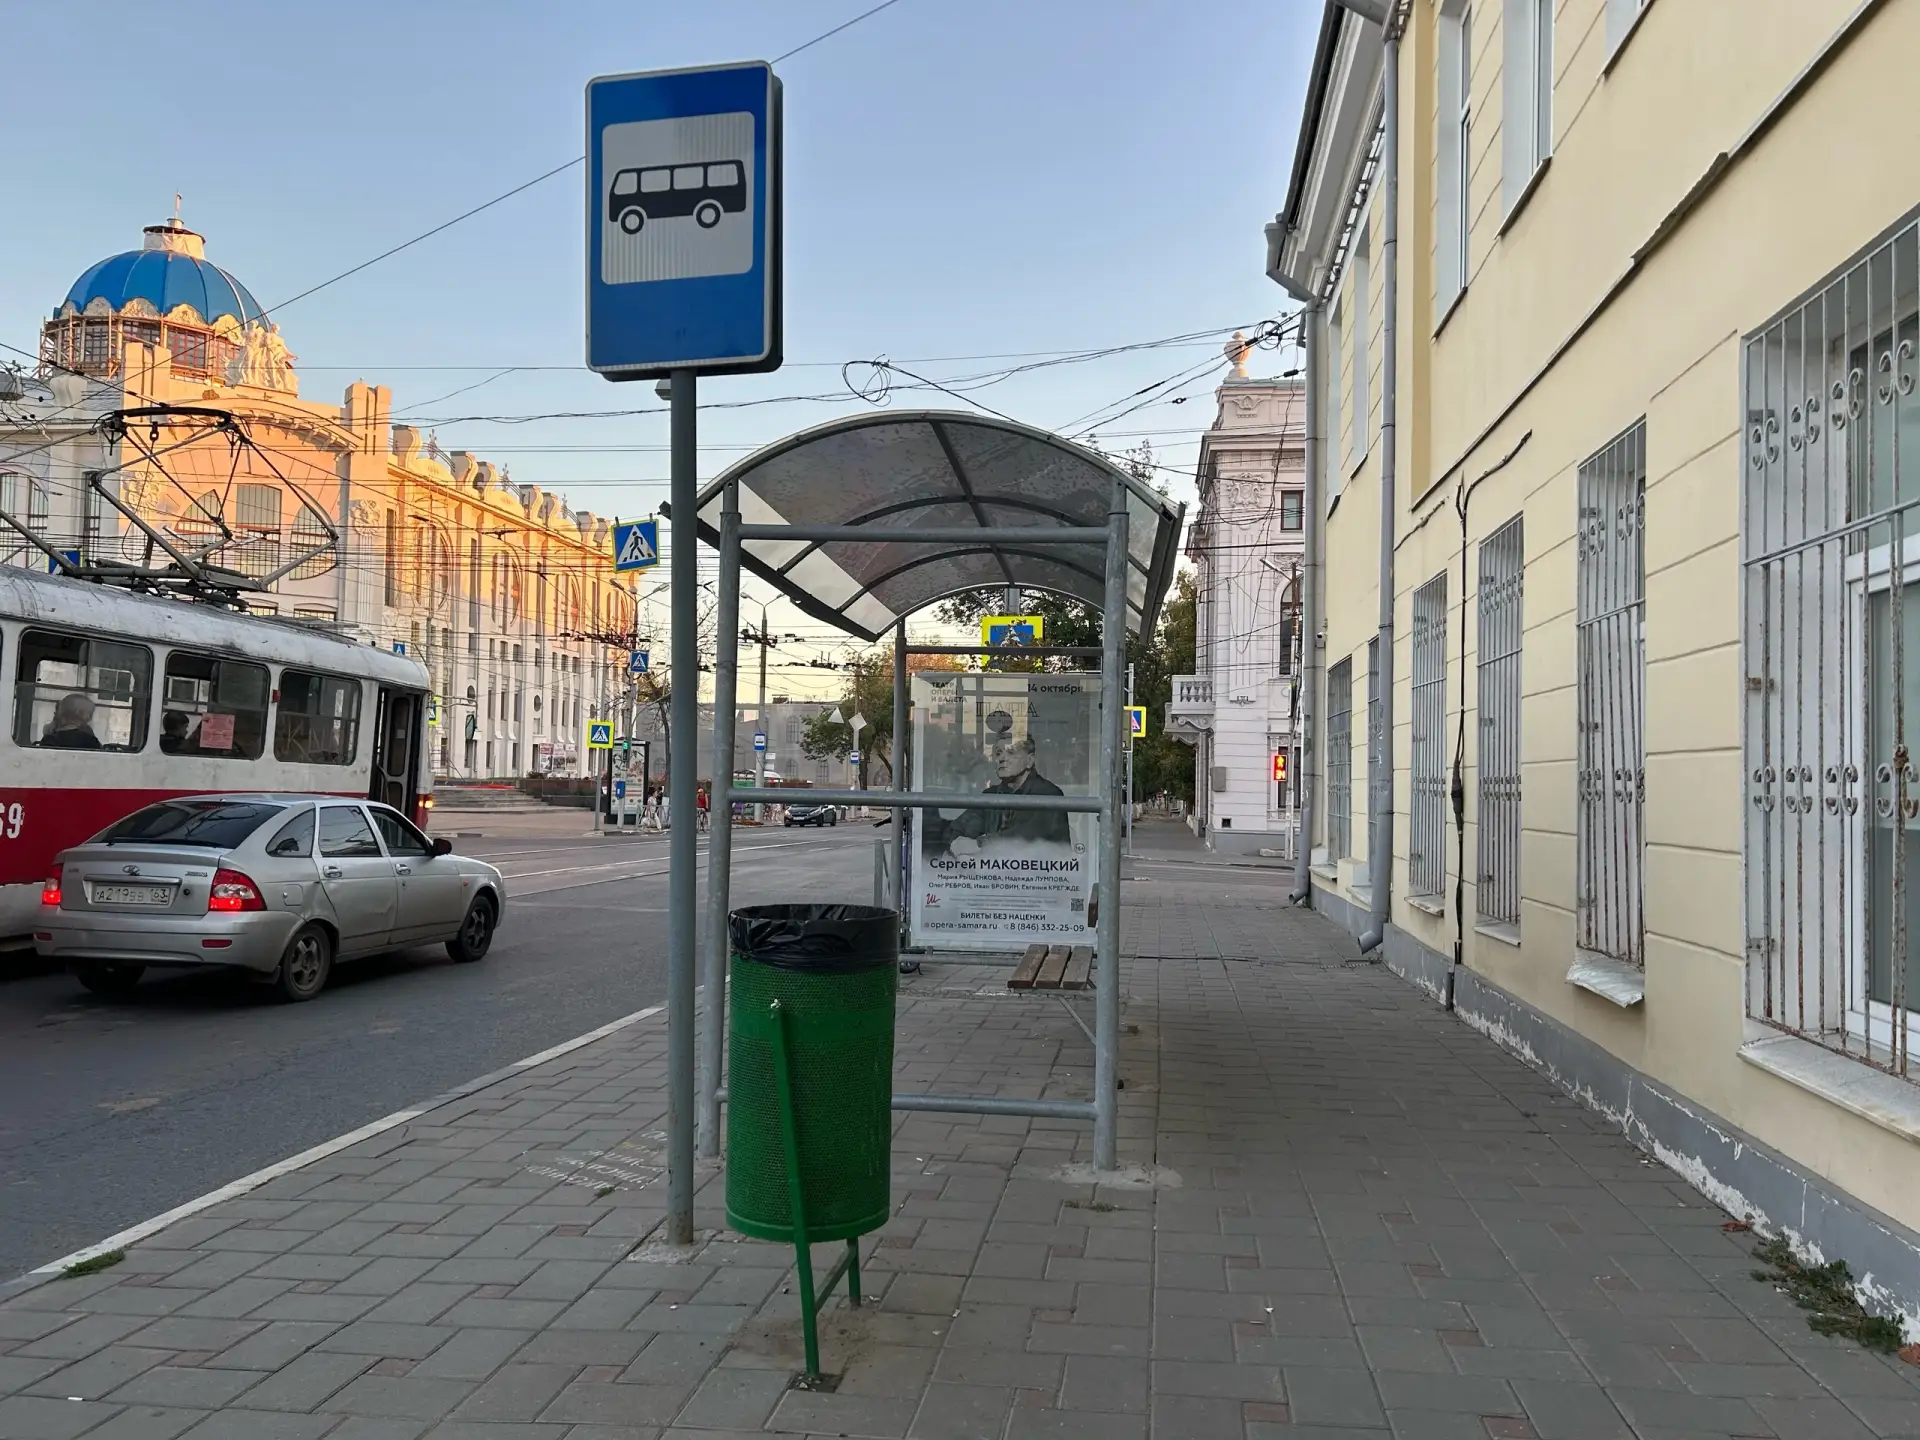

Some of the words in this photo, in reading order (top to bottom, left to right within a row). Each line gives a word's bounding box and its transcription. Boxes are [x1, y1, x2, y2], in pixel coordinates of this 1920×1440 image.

[1028, 683, 1038, 692] 14
[929, 858, 976, 871] Сергей
[980, 859, 1080, 872] МАКОВЕЦКИЙ
[937, 873, 958, 881] Мария
[1005, 875, 1034, 883] Надежда
[1021, 884, 1048, 892] Евгения
[960, 912, 992, 920] БИЛЕТЫ
[1008, 913, 1046, 921] НАЦЕНКИ
[930, 922, 998, 930] opera-samara.ru
[1017, 922, 1039, 932] (846)
[1040, 923, 1085, 932] 332-25-09
